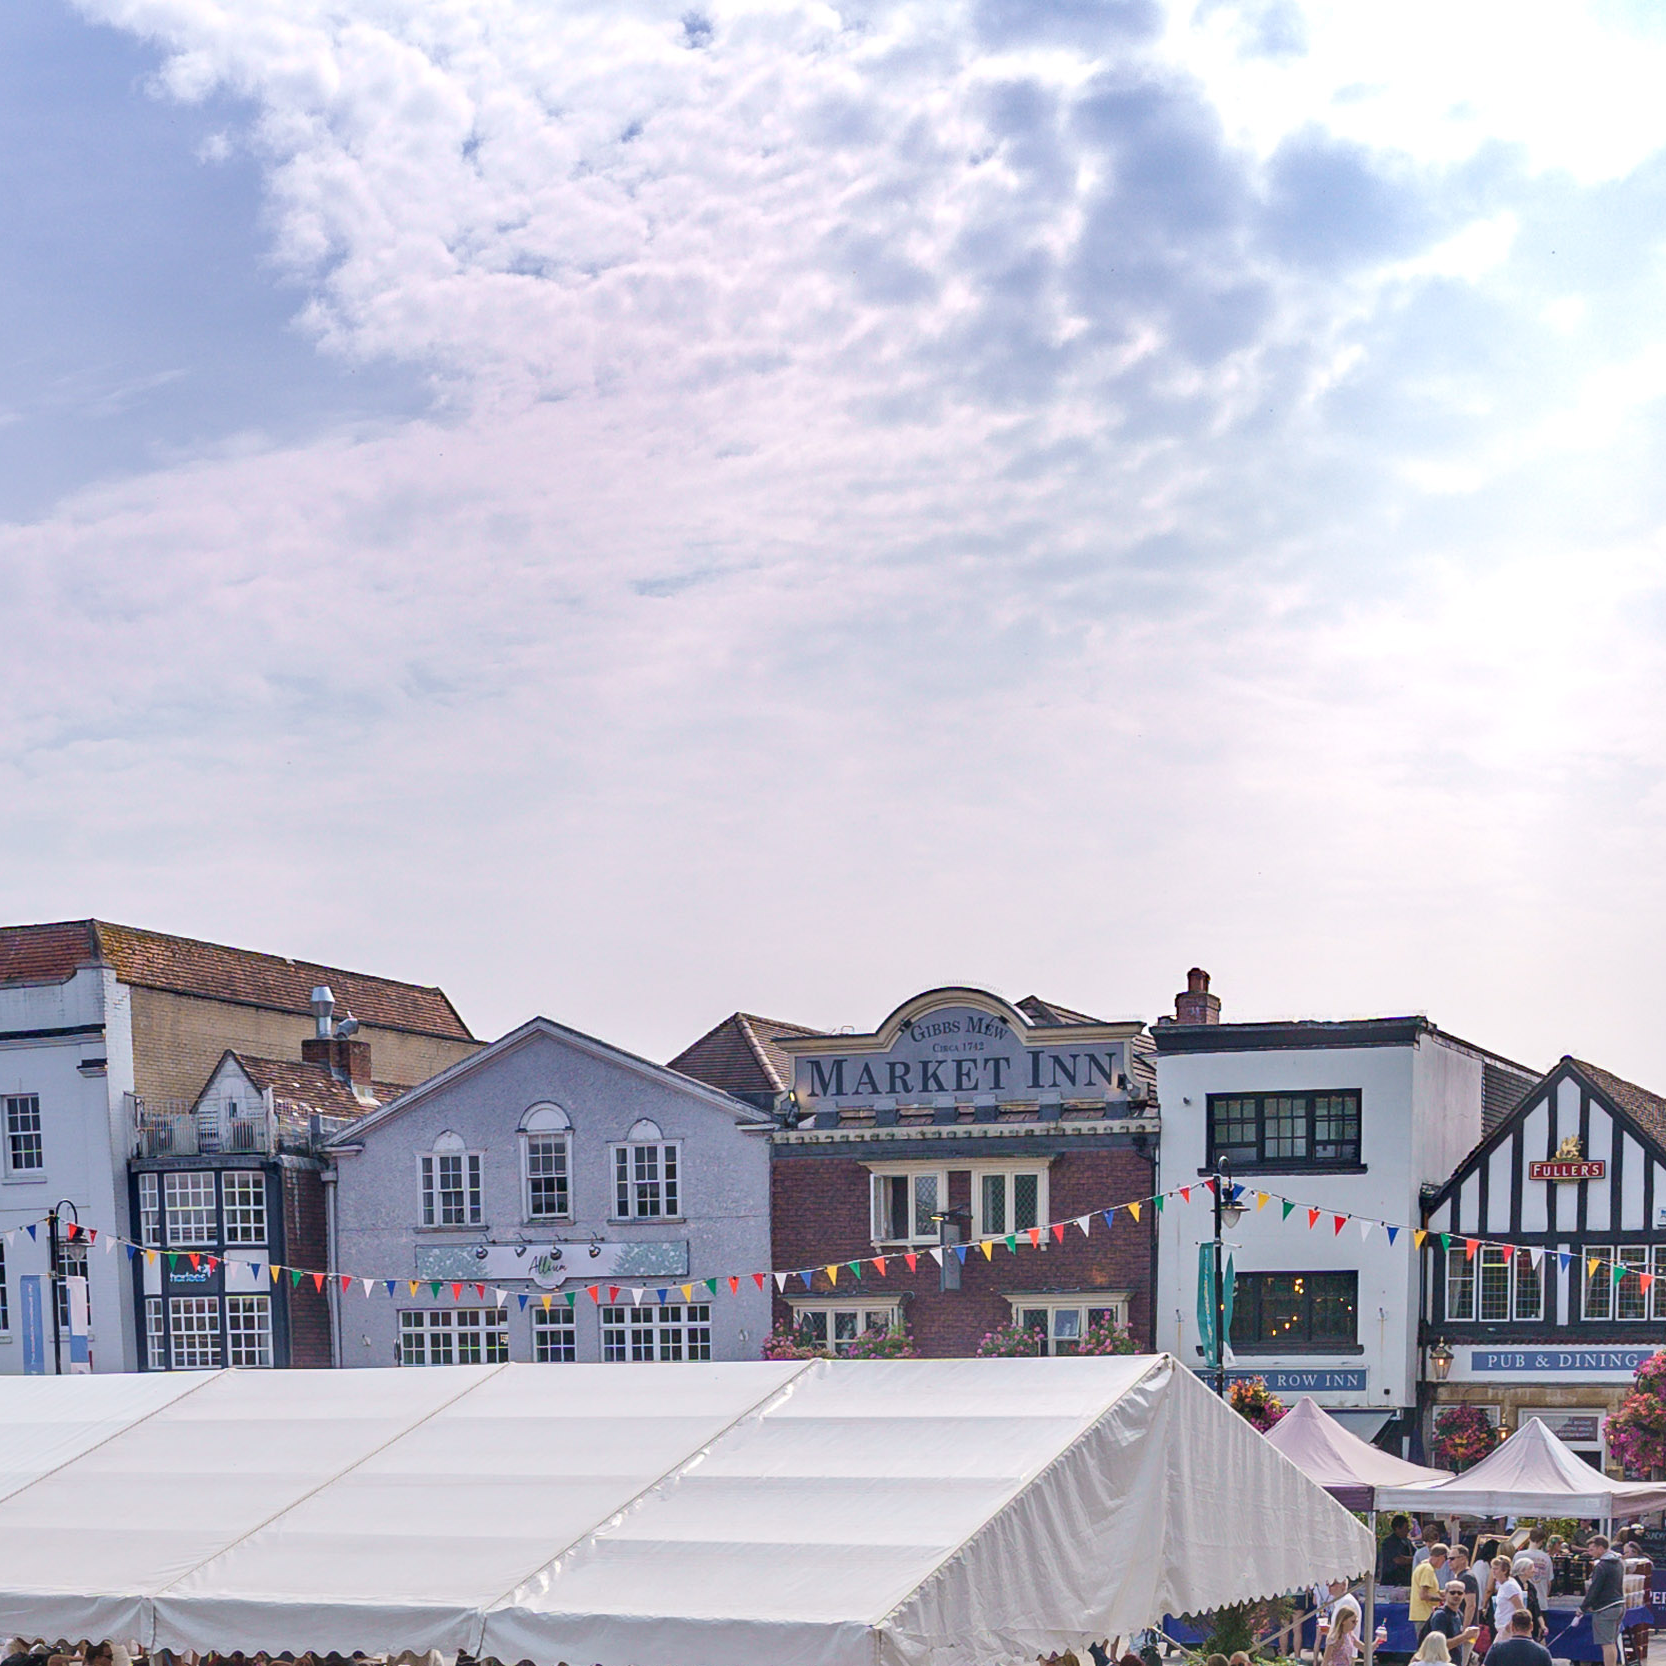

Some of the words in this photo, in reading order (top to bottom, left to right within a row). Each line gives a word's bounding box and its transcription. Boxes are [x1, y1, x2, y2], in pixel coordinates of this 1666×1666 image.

[910, 1019, 961, 1043] GIBBS
[966, 1015, 1008, 1041] MEW
[962, 1041, 984, 1052] 1742
[806, 1057, 1011, 1098] MARKET
[1026, 1050, 1117, 1090] INN
[1533, 1164, 1600, 1177] FULLER'S
[1488, 1354, 1526, 1368] PUB
[1535, 1354, 1550, 1368] &
[1559, 1353, 1639, 1368] DINING
[1277, 1374, 1318, 1387] ROW
[1325, 1374, 1359, 1387] INN
